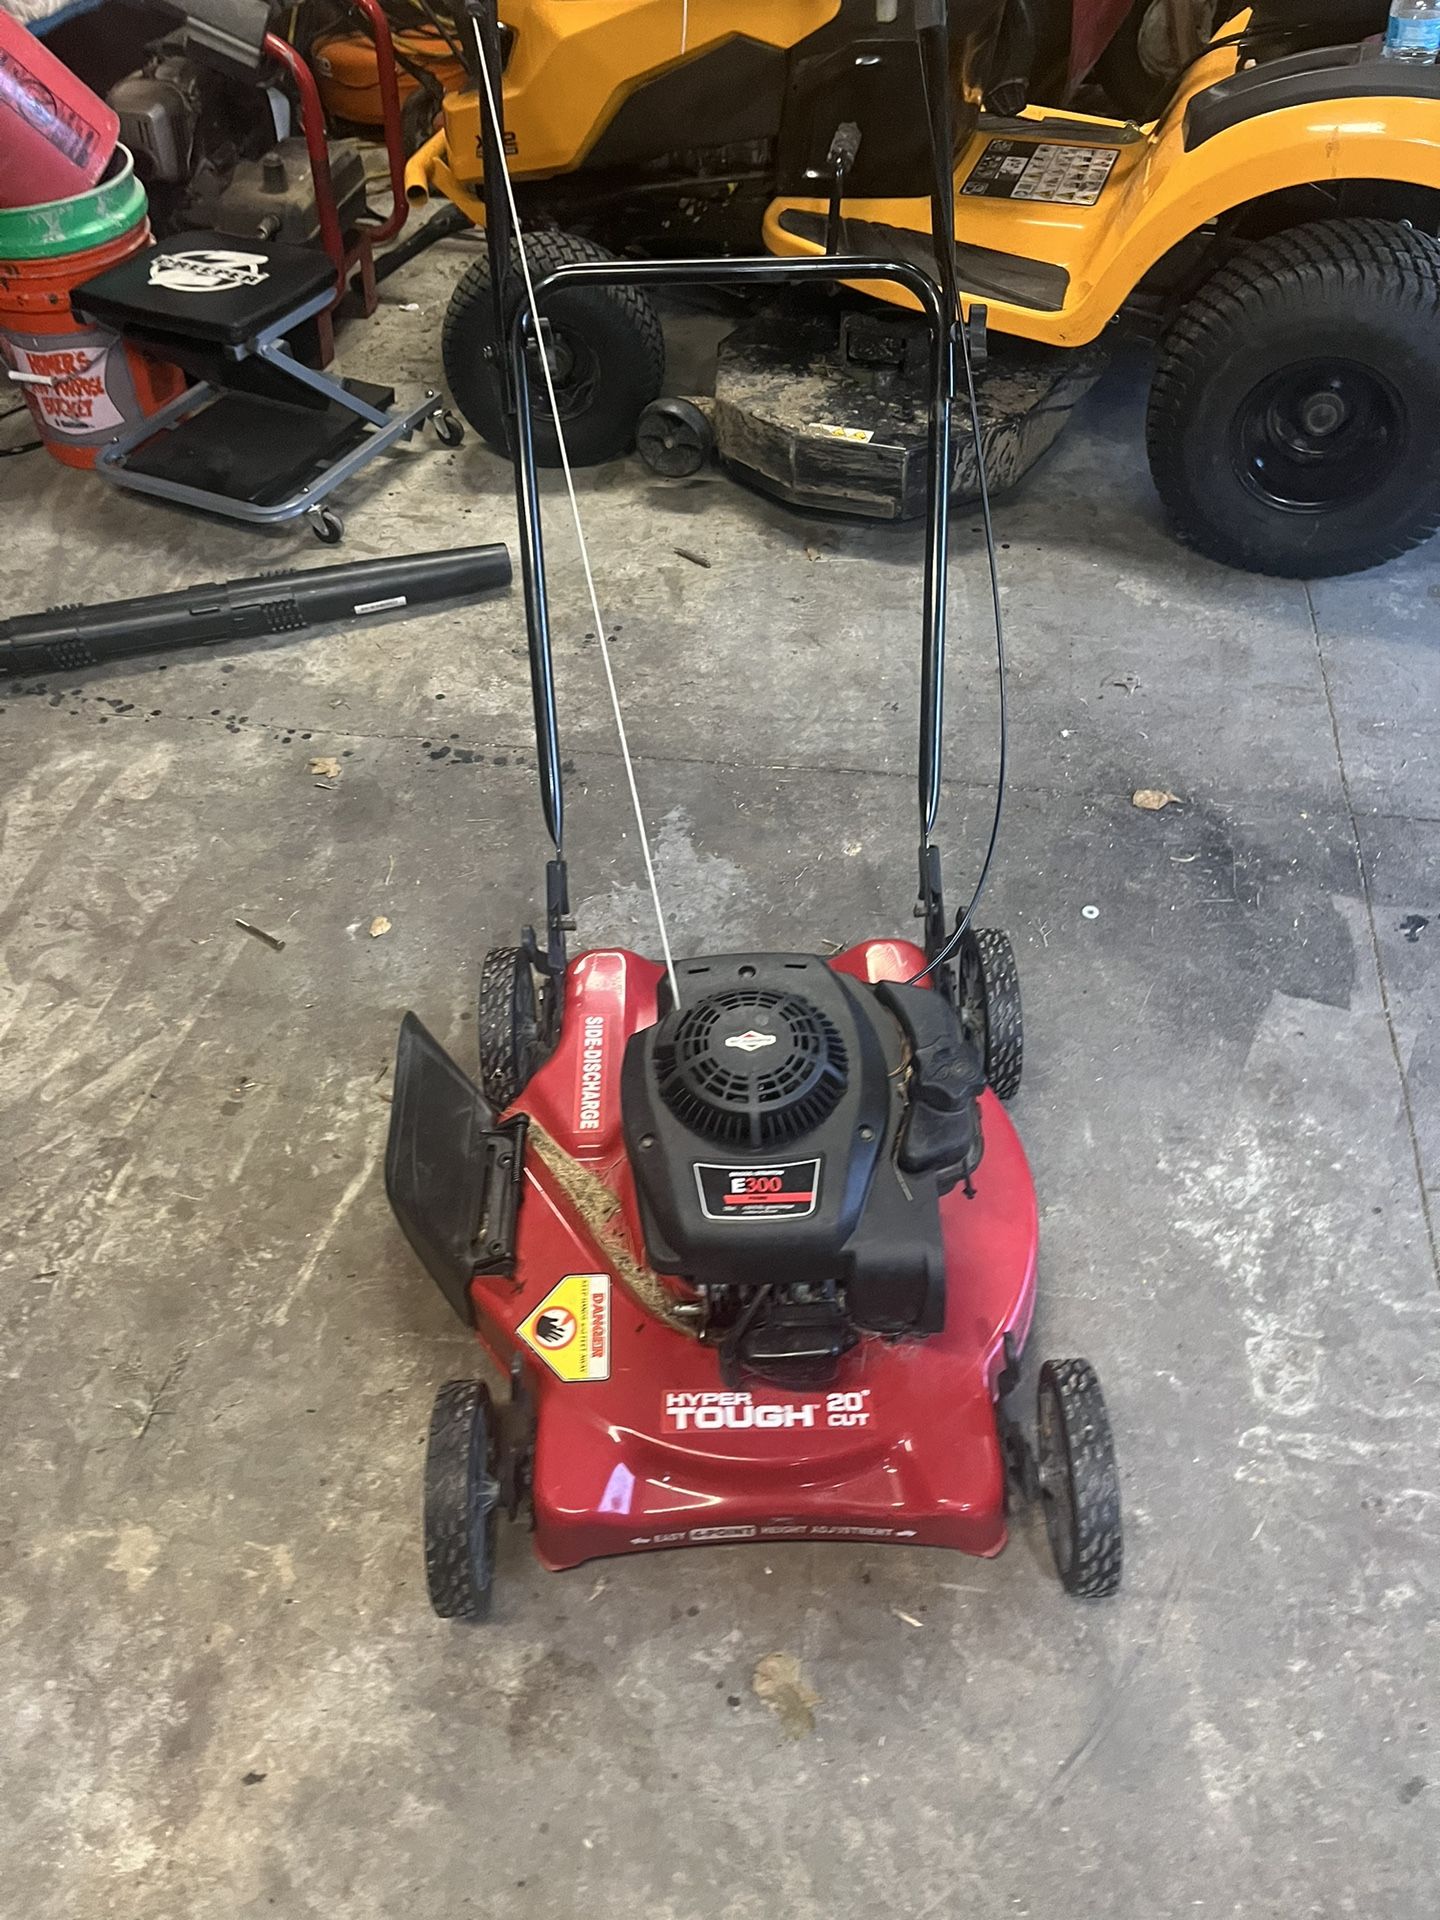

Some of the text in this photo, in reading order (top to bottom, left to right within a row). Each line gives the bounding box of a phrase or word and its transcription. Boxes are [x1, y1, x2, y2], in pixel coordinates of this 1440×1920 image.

[42, 397, 94, 418] BUCKET
[580, 1016, 604, 1130] SIDE-DISCHARGE
[731, 1177, 783, 1194] E300
[592, 1293, 604, 1357] DANGER
[666, 1392, 753, 1406] HYPER
[827, 1413, 870, 1426] CUT
[653, 1531, 687, 1542] EASY
